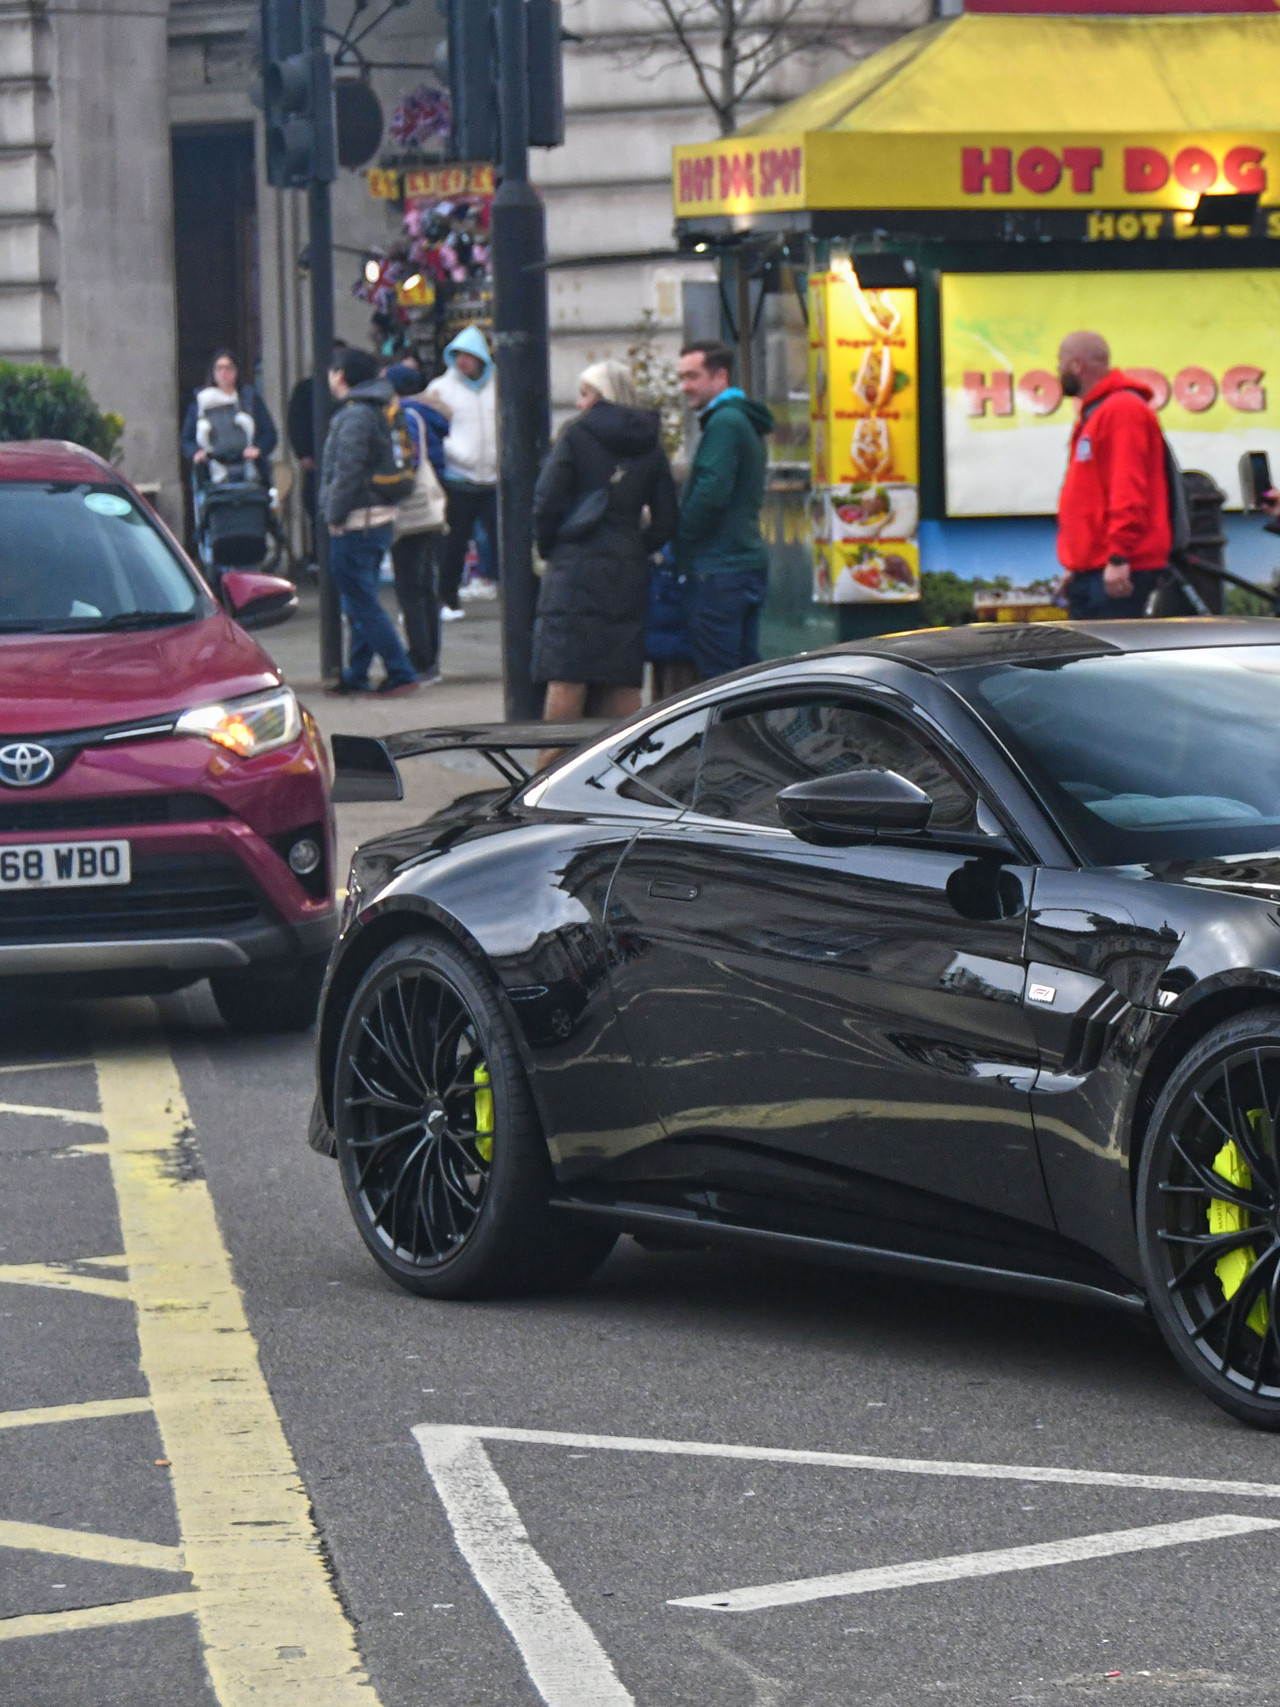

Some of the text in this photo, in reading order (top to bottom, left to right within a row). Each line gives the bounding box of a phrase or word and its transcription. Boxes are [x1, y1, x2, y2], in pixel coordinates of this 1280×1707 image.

[679, 146, 801, 203] HOT DOG SPOT
[961, 146, 1103, 194] HOT
[1124, 146, 1267, 194] DOG
[1088, 212, 1163, 241] HOT
[963, 370, 1082, 417] HO
[54, 845, 121, 880] WBO
